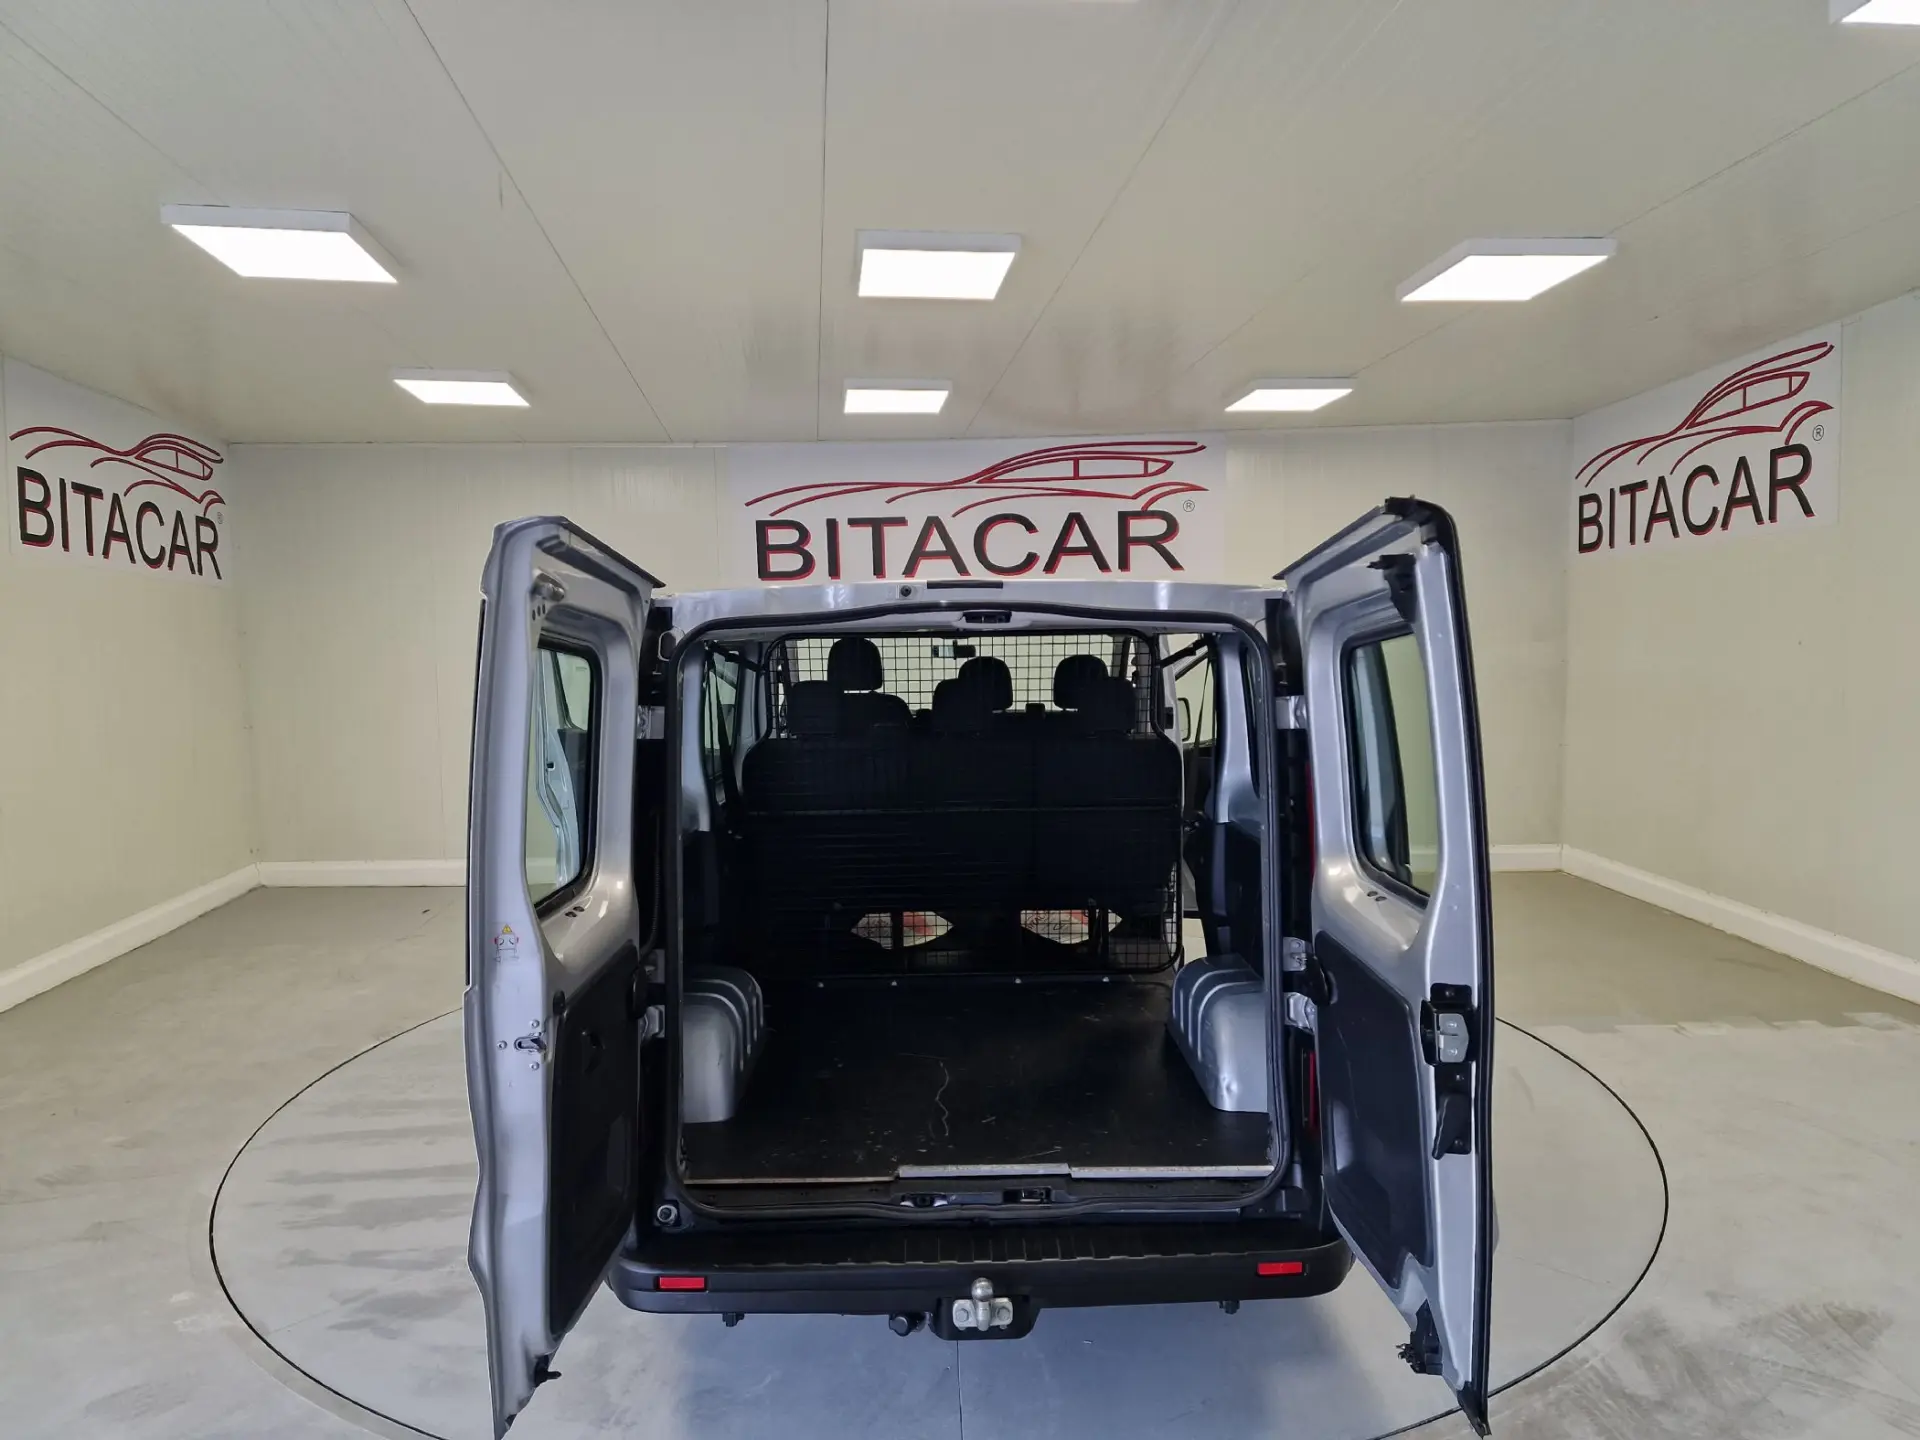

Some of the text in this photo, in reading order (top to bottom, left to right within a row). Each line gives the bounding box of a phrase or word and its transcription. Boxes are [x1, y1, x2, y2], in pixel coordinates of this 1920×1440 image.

[17, 466, 222, 580] BITACAR
[755, 510, 1185, 581] BITACAR
[1578, 443, 1815, 554] BITACAR
